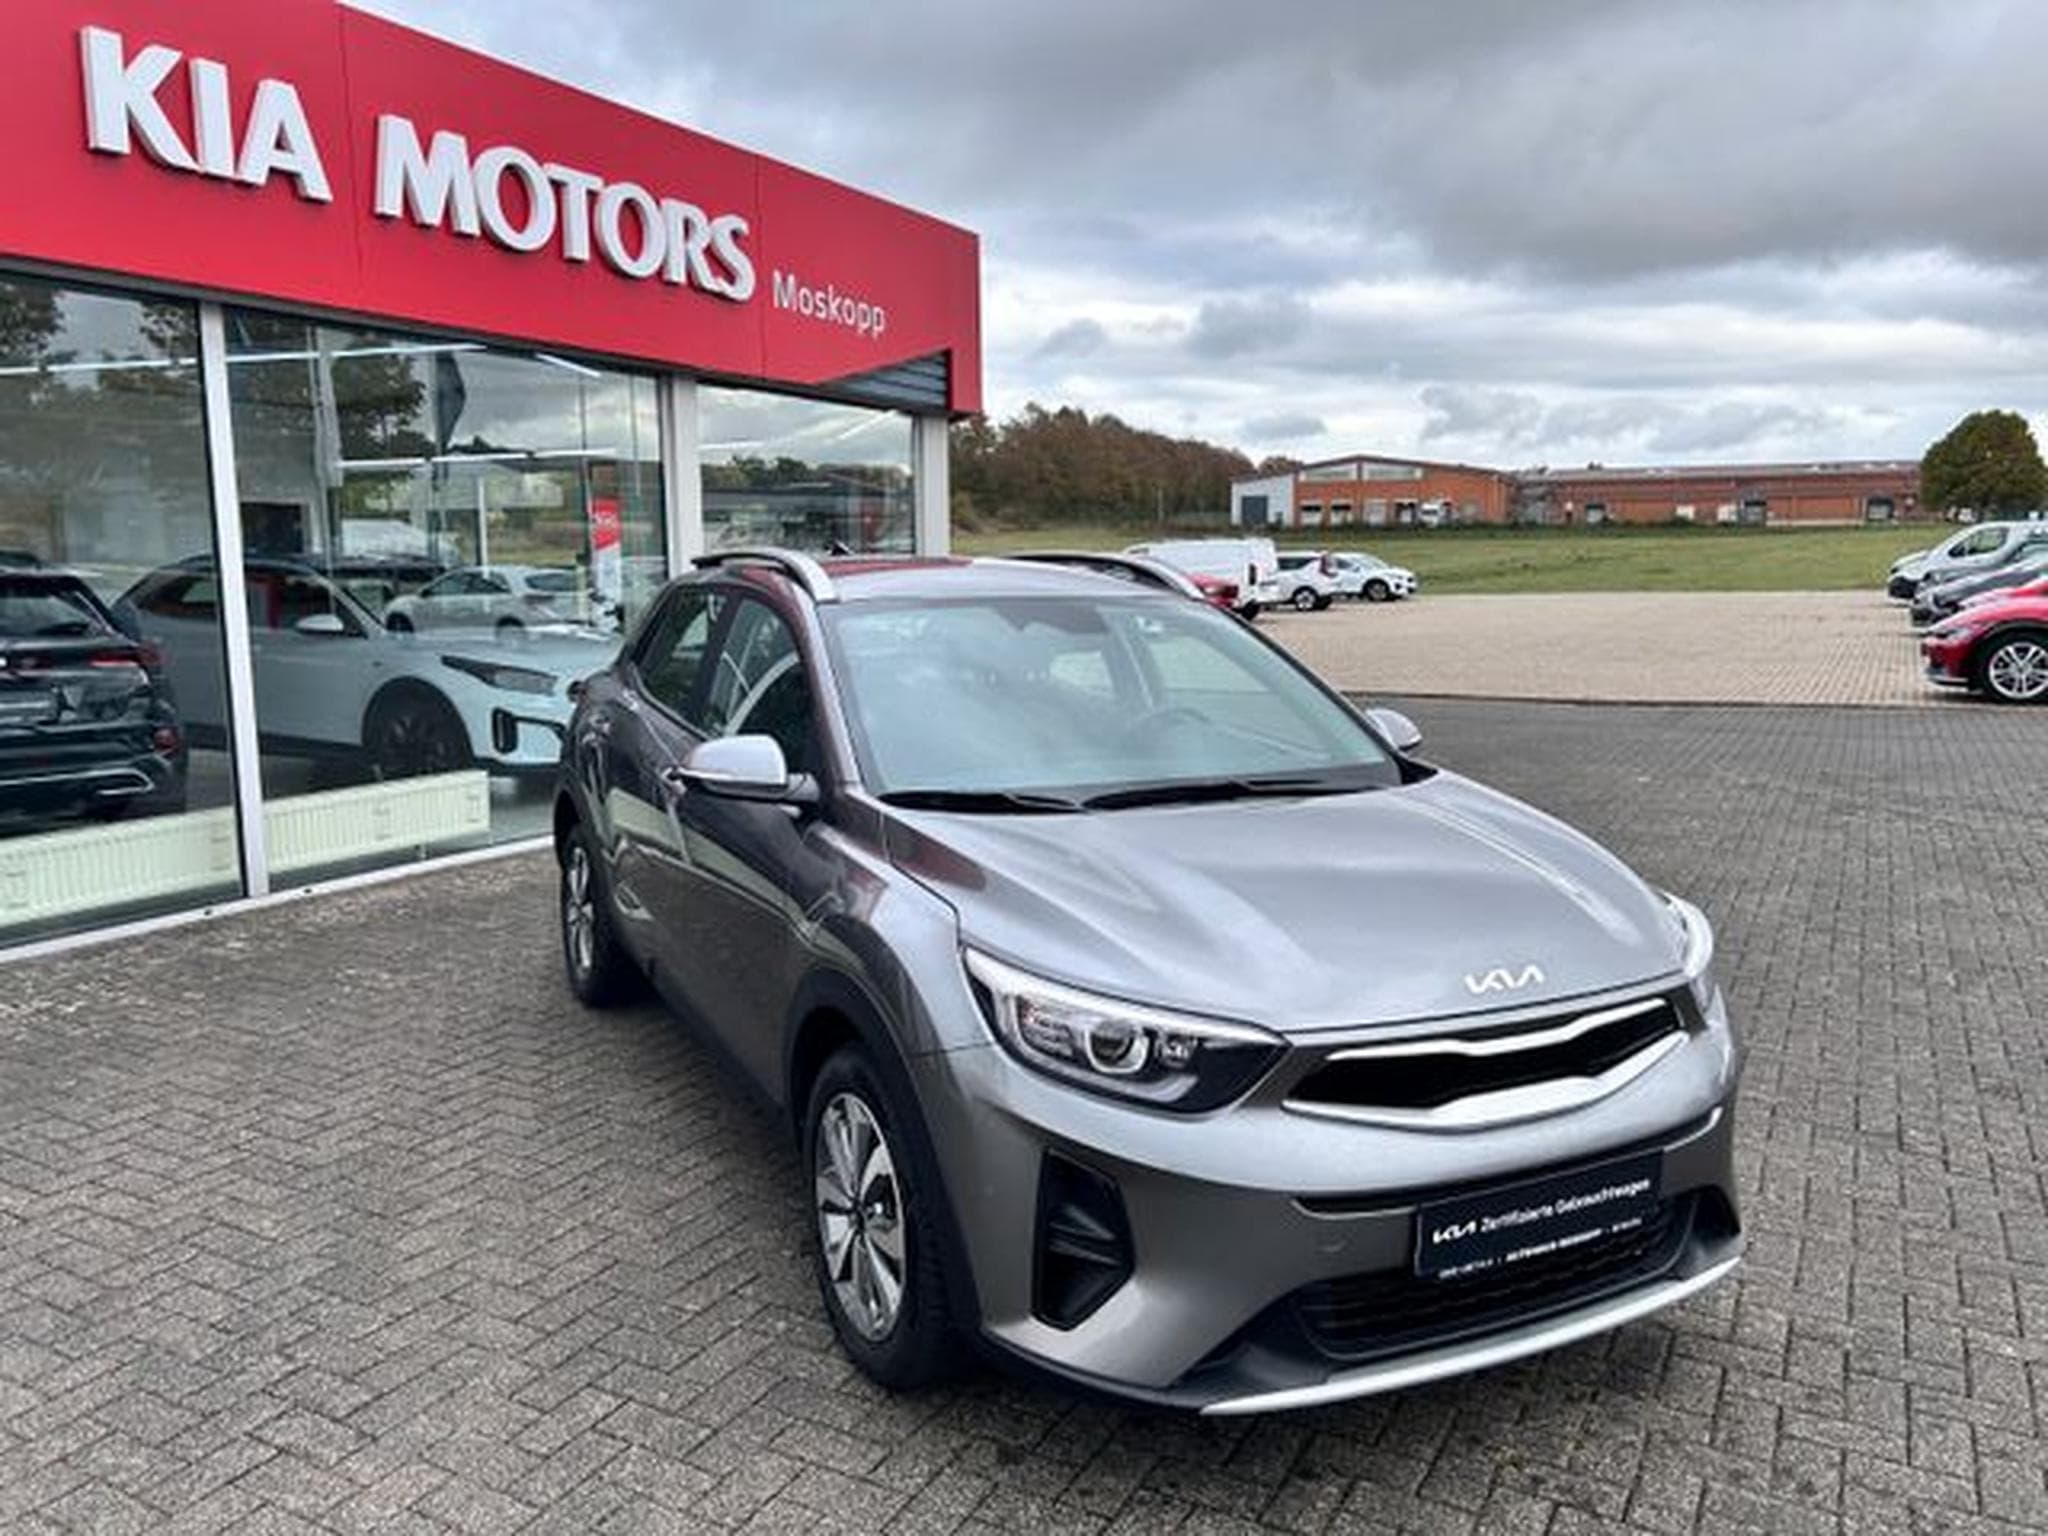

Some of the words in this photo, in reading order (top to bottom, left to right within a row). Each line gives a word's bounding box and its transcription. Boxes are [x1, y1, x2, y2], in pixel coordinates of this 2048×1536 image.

[80, 26, 332, 203] KIA
[374, 114, 757, 303] MOTORS
[773, 269, 886, 338] Moskopp
